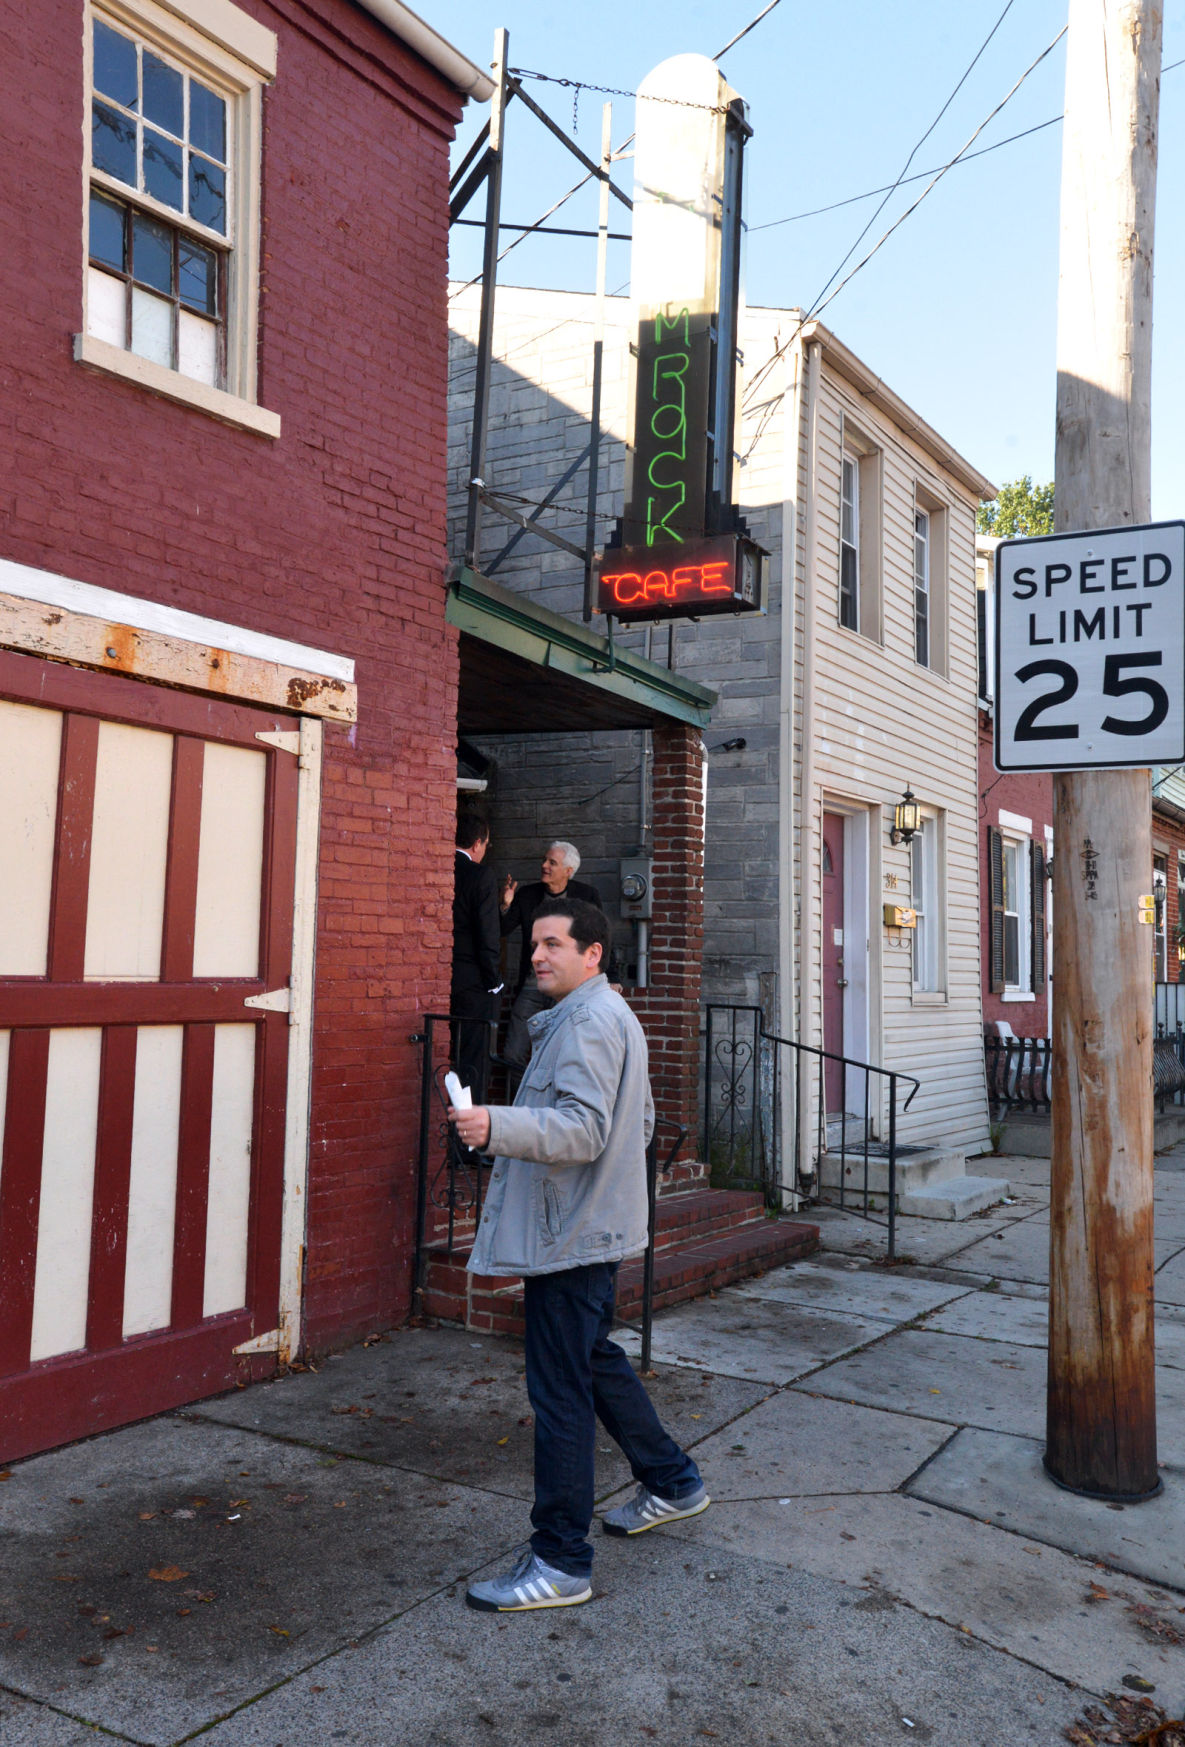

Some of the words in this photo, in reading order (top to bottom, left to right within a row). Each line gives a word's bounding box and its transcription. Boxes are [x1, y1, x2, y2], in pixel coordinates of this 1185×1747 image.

[601, 561, 731, 603] CAFE
[1012, 553, 1172, 600] SPEED
[1029, 602, 1152, 646] LIMIT
[1013, 651, 1169, 741] 25
